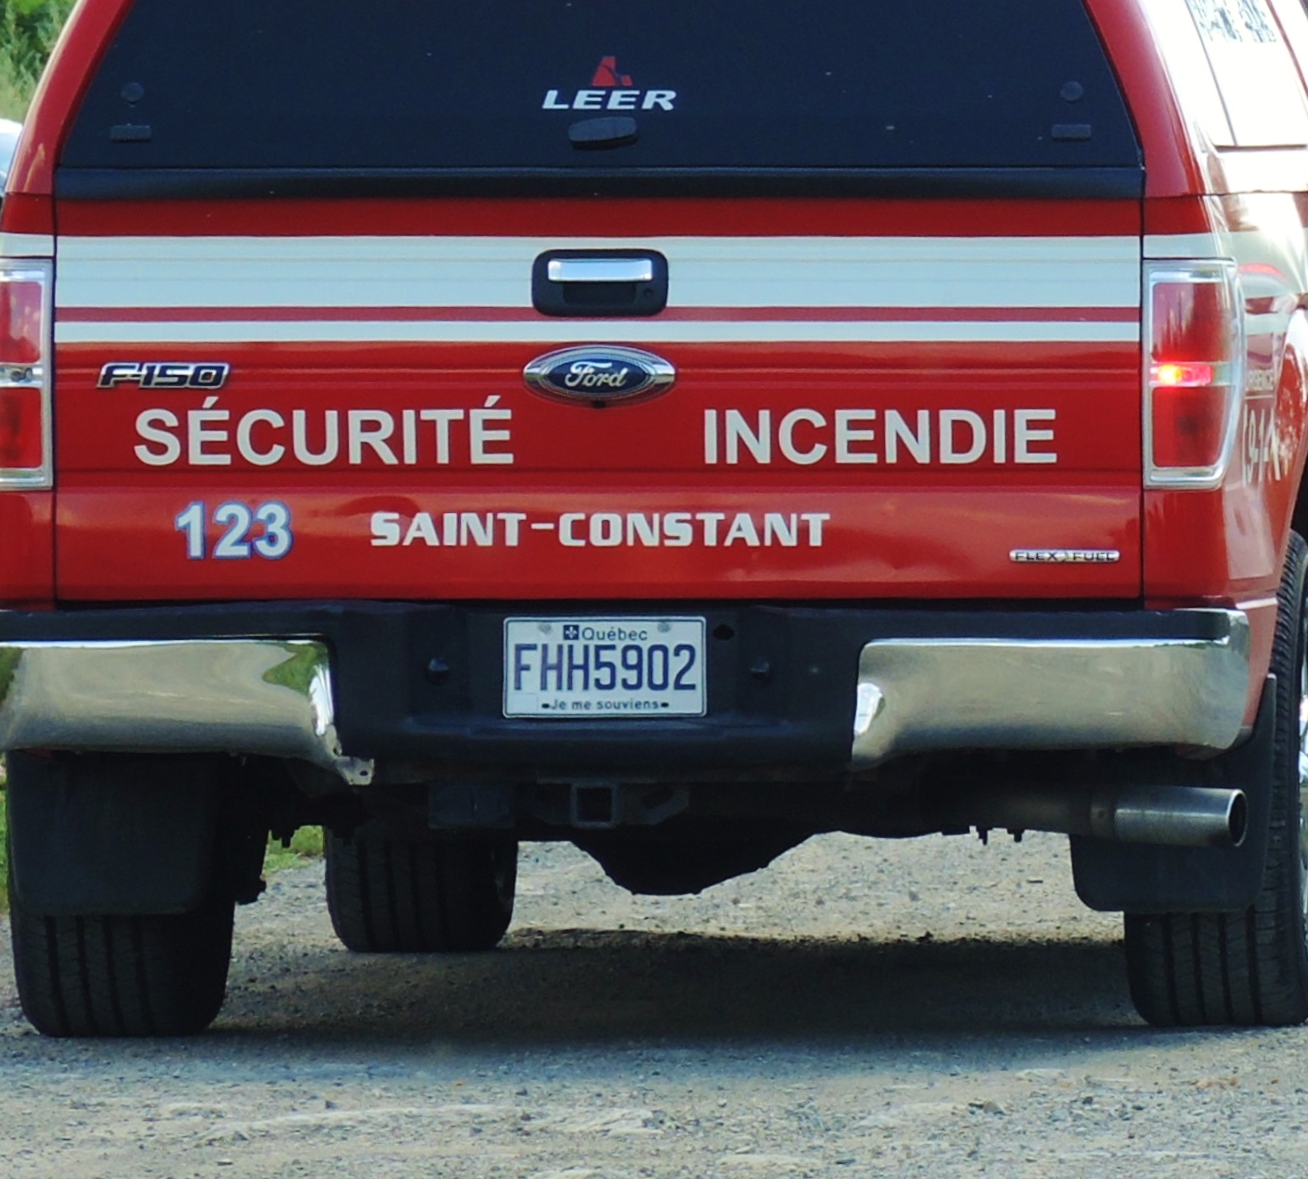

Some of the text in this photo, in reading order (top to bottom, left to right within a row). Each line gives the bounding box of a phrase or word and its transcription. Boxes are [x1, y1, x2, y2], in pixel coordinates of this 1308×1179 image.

[542, 90, 677, 110] LEER
[98, 363, 229, 388] F-150
[565, 361, 628, 387] Ford
[134, 396, 1057, 465] SÉCURITÉ INCENDIE
[175, 501, 294, 559] 123
[371, 512, 830, 547] SAINT-CONSTANT
[1015, 552, 1115, 561] FLEX FUEL
[581, 626, 649, 641] Québec
[514, 644, 697, 691] FHH5902
[551, 699, 660, 710] Je me souviens
